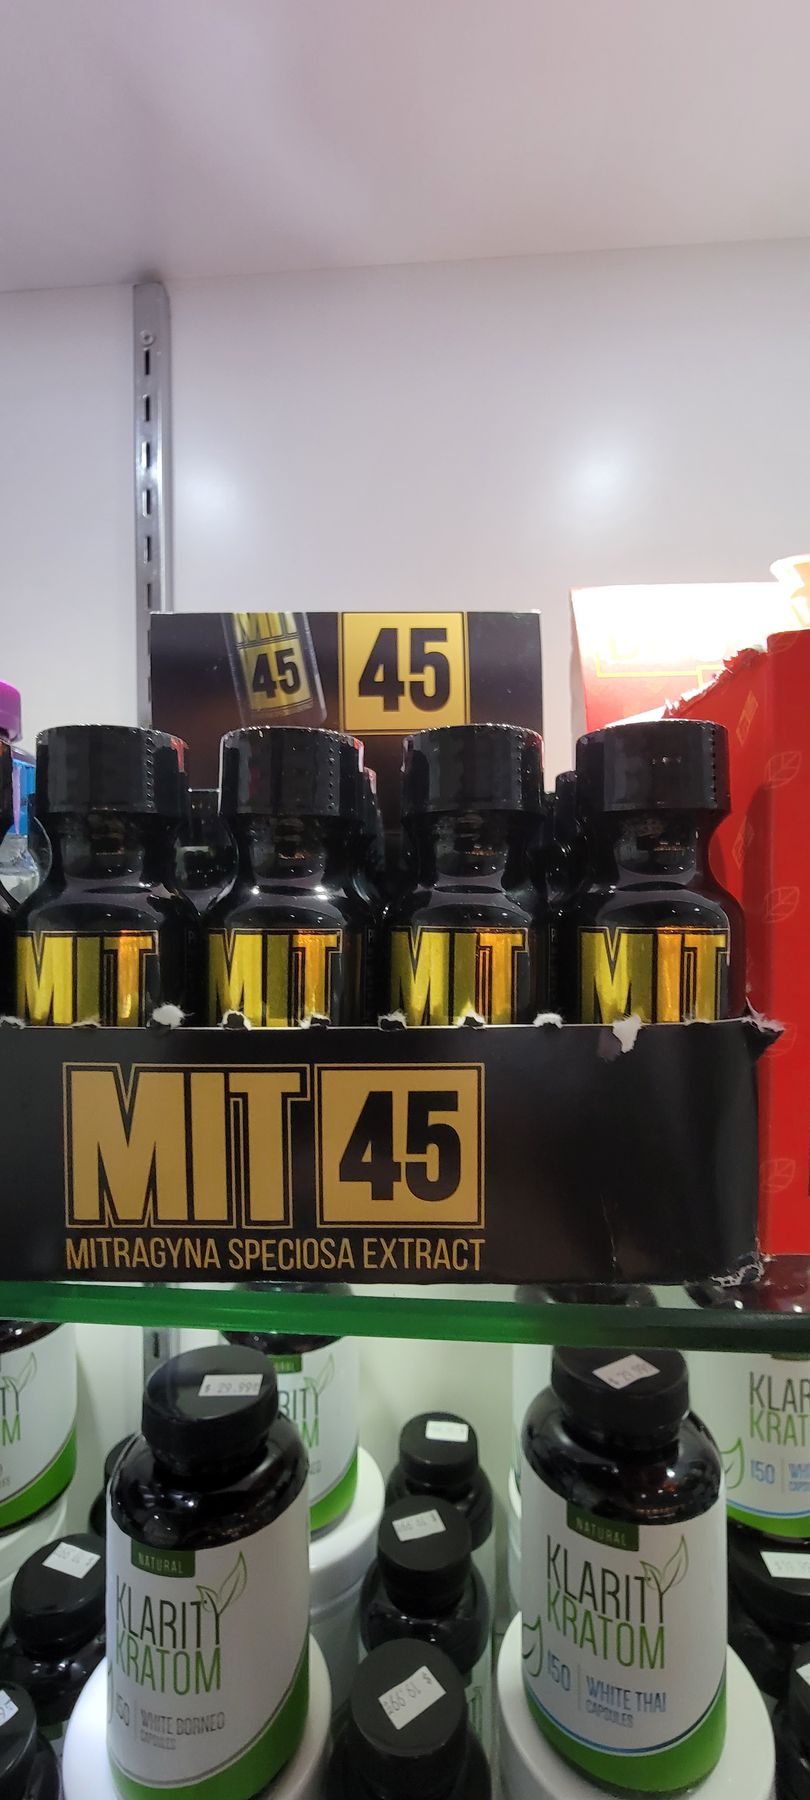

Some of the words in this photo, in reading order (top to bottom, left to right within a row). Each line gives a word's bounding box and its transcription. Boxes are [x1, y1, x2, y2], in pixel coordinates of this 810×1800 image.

[252, 647, 301, 699] 45
[358, 627, 451, 713] 45
[15, 929, 157, 1027] MIT
[208, 928, 342, 1027] MIT
[390, 927, 528, 1026] MIT
[578, 927, 728, 1025] MIT
[64, 1063, 310, 1228] MIT
[338, 1090, 462, 1202] 45
[65, 1237, 221, 1270] MITRAGYNA
[228, 1238, 355, 1272] SPECIOSA
[363, 1238, 486, 1272] EXTRACT
[278, 1382, 320, 1421] RITY
[750, 1371, 810, 1413] KLAR
[750, 1408, 809, 1447] KRAT
[138, 1552, 184, 1574] NATURAL
[576, 1517, 627, 1547] NATURAL
[547, 1534, 671, 1624] KLARITY
[116, 1575, 222, 1649] KLARITY
[547, 1578, 665, 1670] KRATOM
[116, 1620, 221, 1696] KRATOM
[547, 1650, 572, 1692] 150
[140, 1708, 174, 1736] WHITE
[586, 1675, 631, 1711] WHITE
[635, 1691, 667, 1713] THAI
